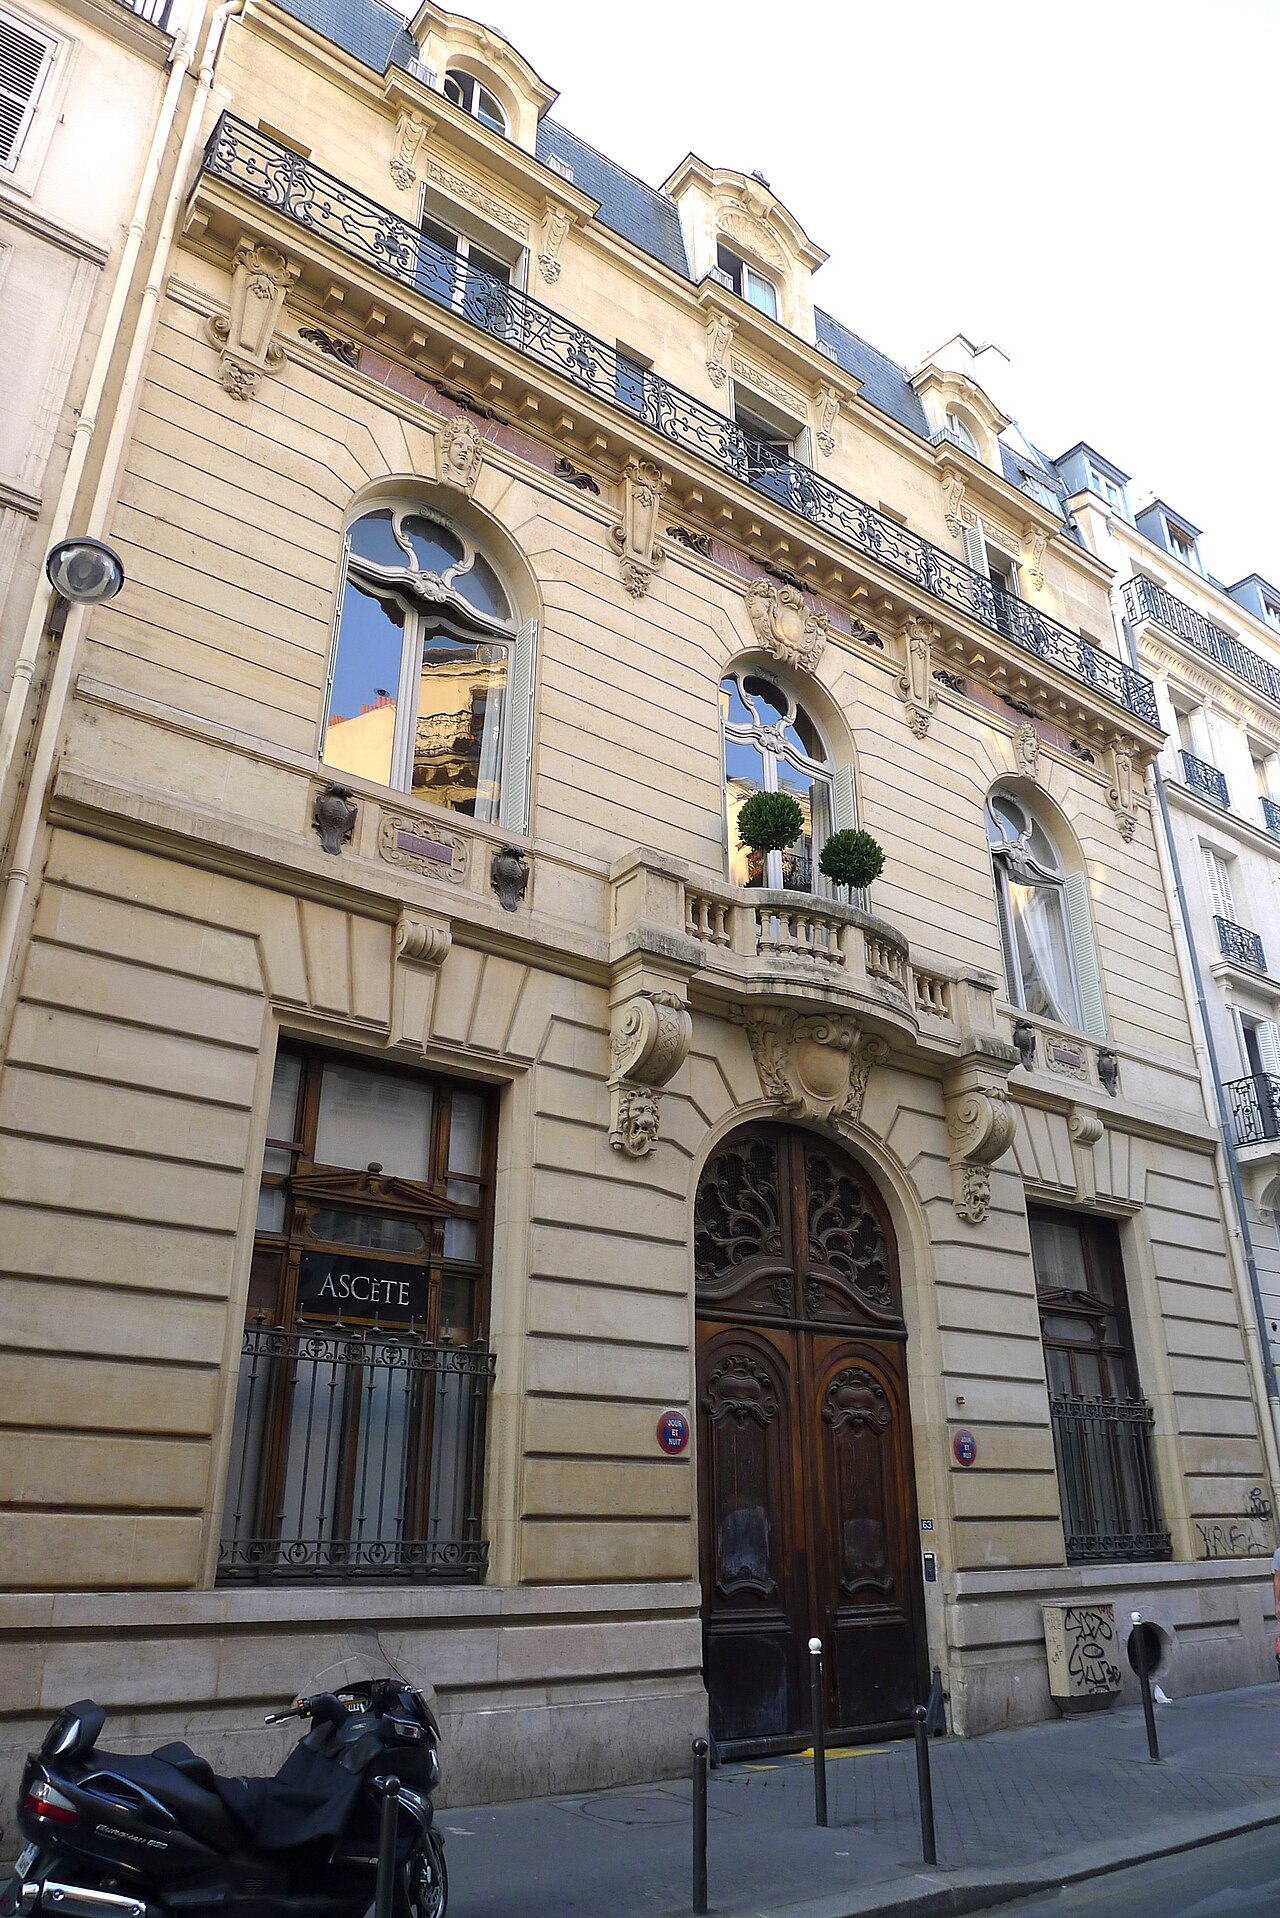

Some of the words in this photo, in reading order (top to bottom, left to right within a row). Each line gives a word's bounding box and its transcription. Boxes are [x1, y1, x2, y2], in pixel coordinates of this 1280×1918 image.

[317, 1272, 411, 1306] ASCÈTE
[671, 1428, 679, 1437] ET
[668, 1438, 681, 1446] NUIT
[922, 1520, 932, 1529] 63
